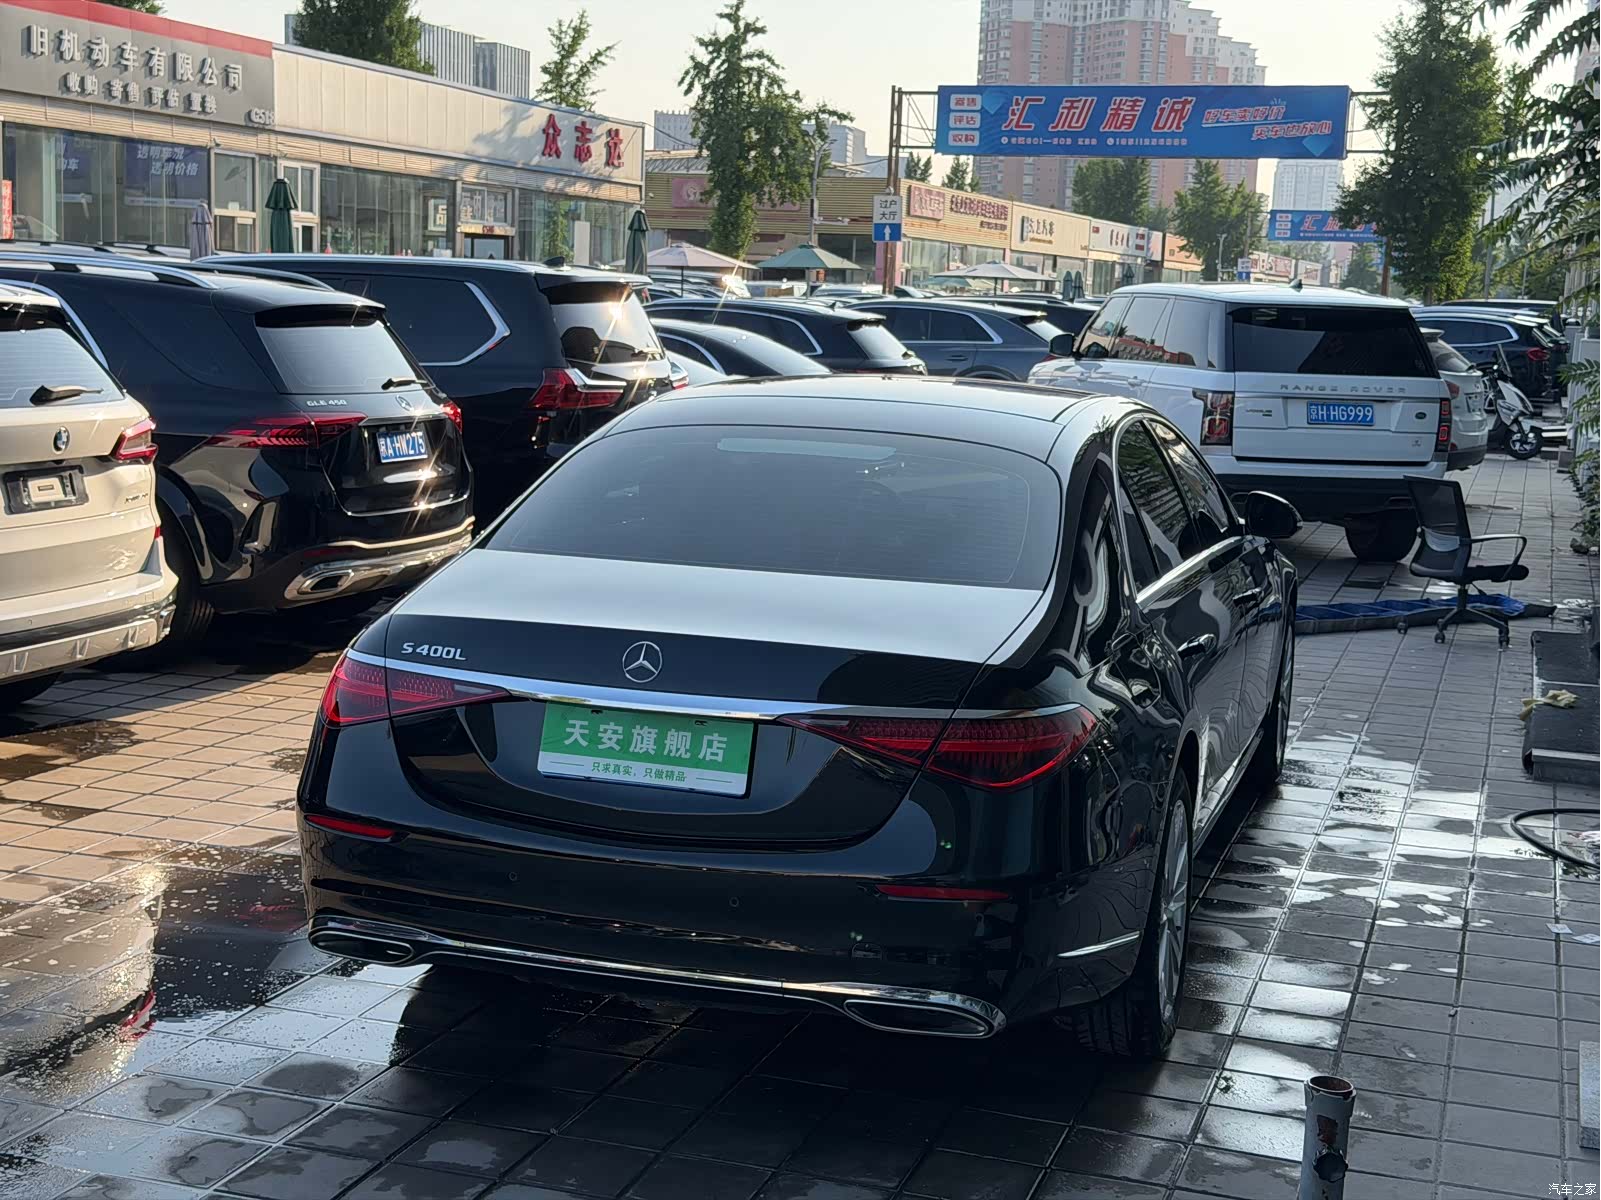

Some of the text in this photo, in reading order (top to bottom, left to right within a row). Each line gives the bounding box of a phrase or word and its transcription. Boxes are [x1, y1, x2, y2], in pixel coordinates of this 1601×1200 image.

[30, 24, 243, 90] 旧机动车有限公司
[67, 72, 217, 114] 收购 寄售 评估 置换
[953, 115, 976, 126] 评估
[1001, 96, 1196, 132] 汇利精诚
[1202, 105, 1286, 124] 好车卖好价
[1251, 120, 1333, 140] 买车也放心
[151, 161, 199, 176] 透明价格
[879, 199, 898, 209] 过户
[879, 211, 898, 221] 大厅
[1280, 384, 1406, 394] RANGE ROVER
[563, 719, 728, 763] 天安旗舰店
[591, 761, 687, 783] 只求真实，只做精品
